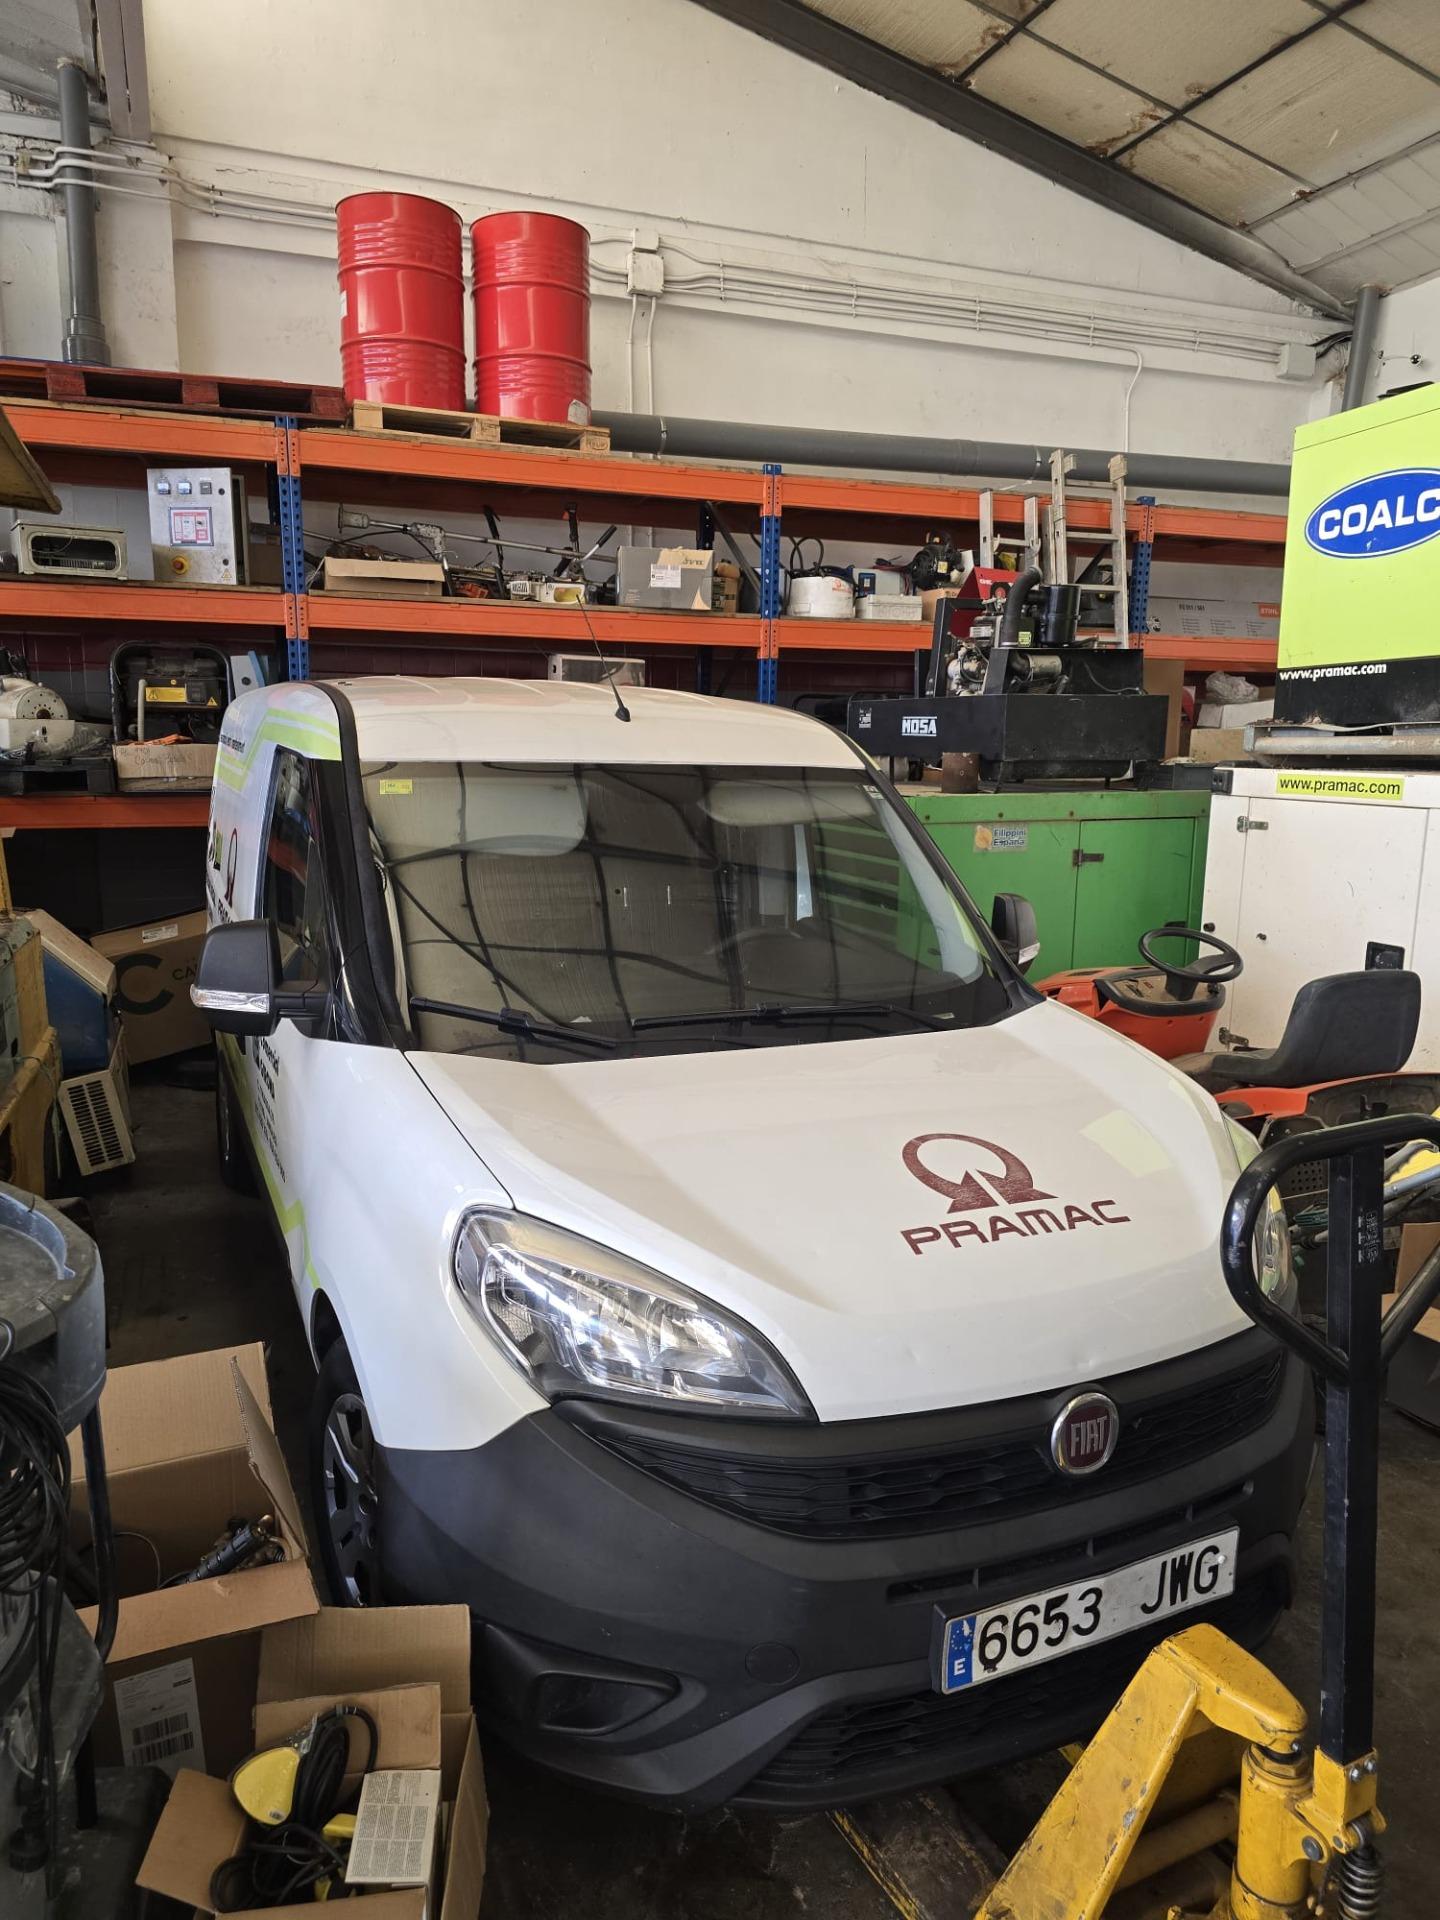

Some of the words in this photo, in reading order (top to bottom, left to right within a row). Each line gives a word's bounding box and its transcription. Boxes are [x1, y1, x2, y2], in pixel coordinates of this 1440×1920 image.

[1279, 663, 1388, 682] www.pramac.com
[901, 718, 937, 735] MOSA
[1279, 778, 1401, 795] www.pramac.com
[993, 828, 1026, 838] Filippini
[900, 1199, 1132, 1256] PRAMAC
[1070, 1415, 1108, 1458] FIAT
[978, 1586, 1103, 1670] 6653
[1140, 1545, 1221, 1615] JWG
[954, 1657, 967, 1676] E
